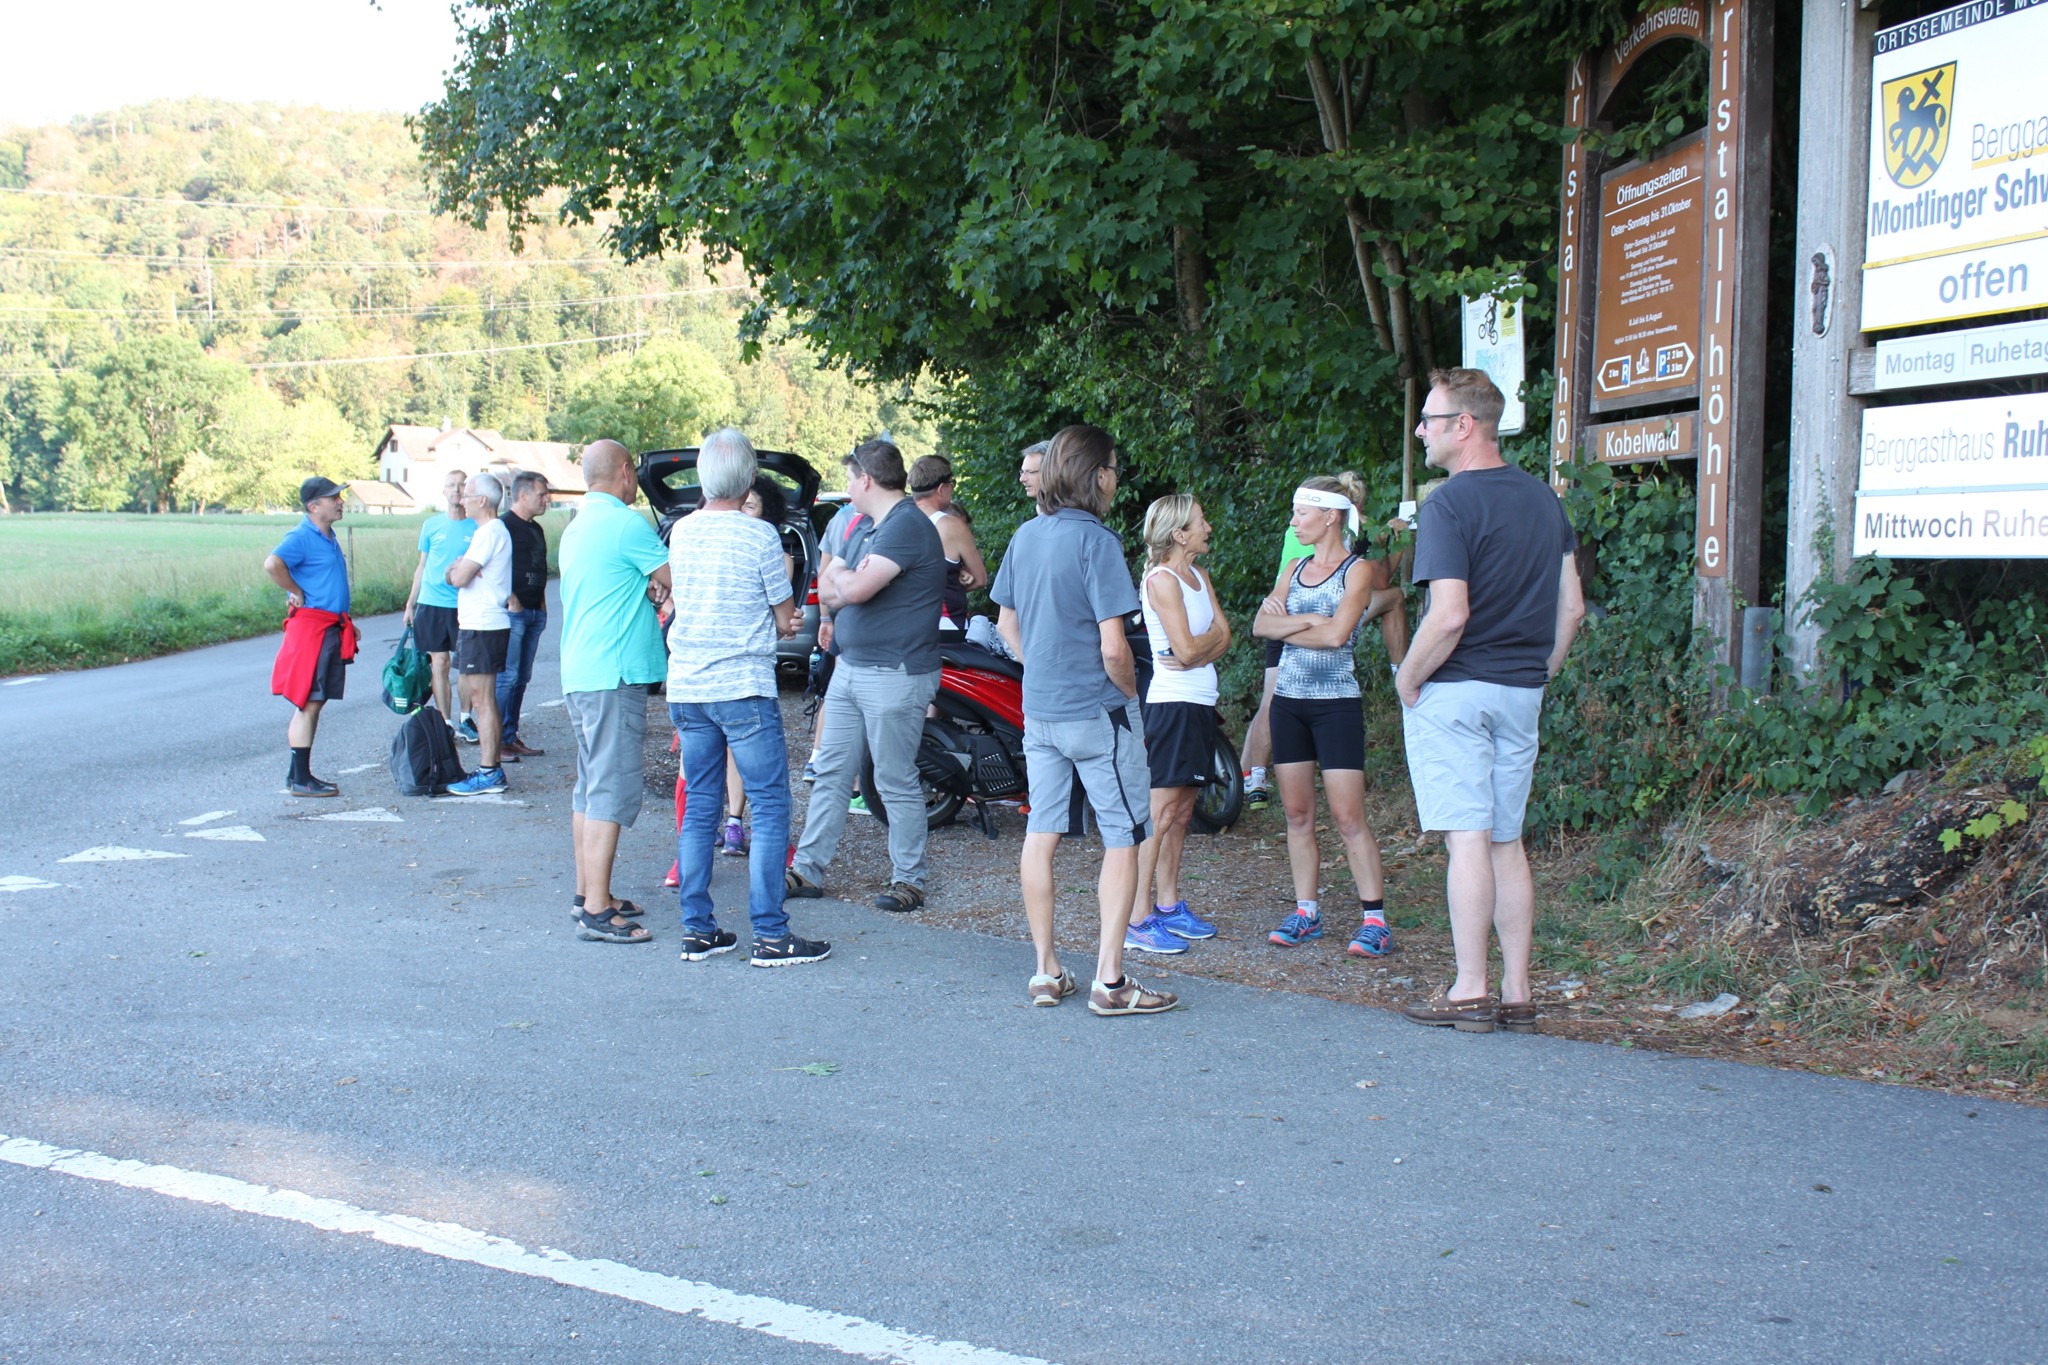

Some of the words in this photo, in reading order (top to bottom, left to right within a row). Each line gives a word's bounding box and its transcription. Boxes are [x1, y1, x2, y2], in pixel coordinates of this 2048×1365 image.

[1615, 2, 1700, 65] Verkehrsverein
[1877, 0, 2005, 53] ORTSGEMEINDE
[1972, 115, 2048, 162] Bergga
[1617, 165, 1688, 205] Öffnungszeiten
[1870, 186, 1988, 237] Montlinger
[1704, 0, 1734, 568] ristallhöhle
[1939, 260, 2028, 304] offen
[1885, 351, 1956, 374] Montag
[1864, 427, 1995, 473] Berggasthaus
[1865, 510, 1973, 539] Mittwoch
